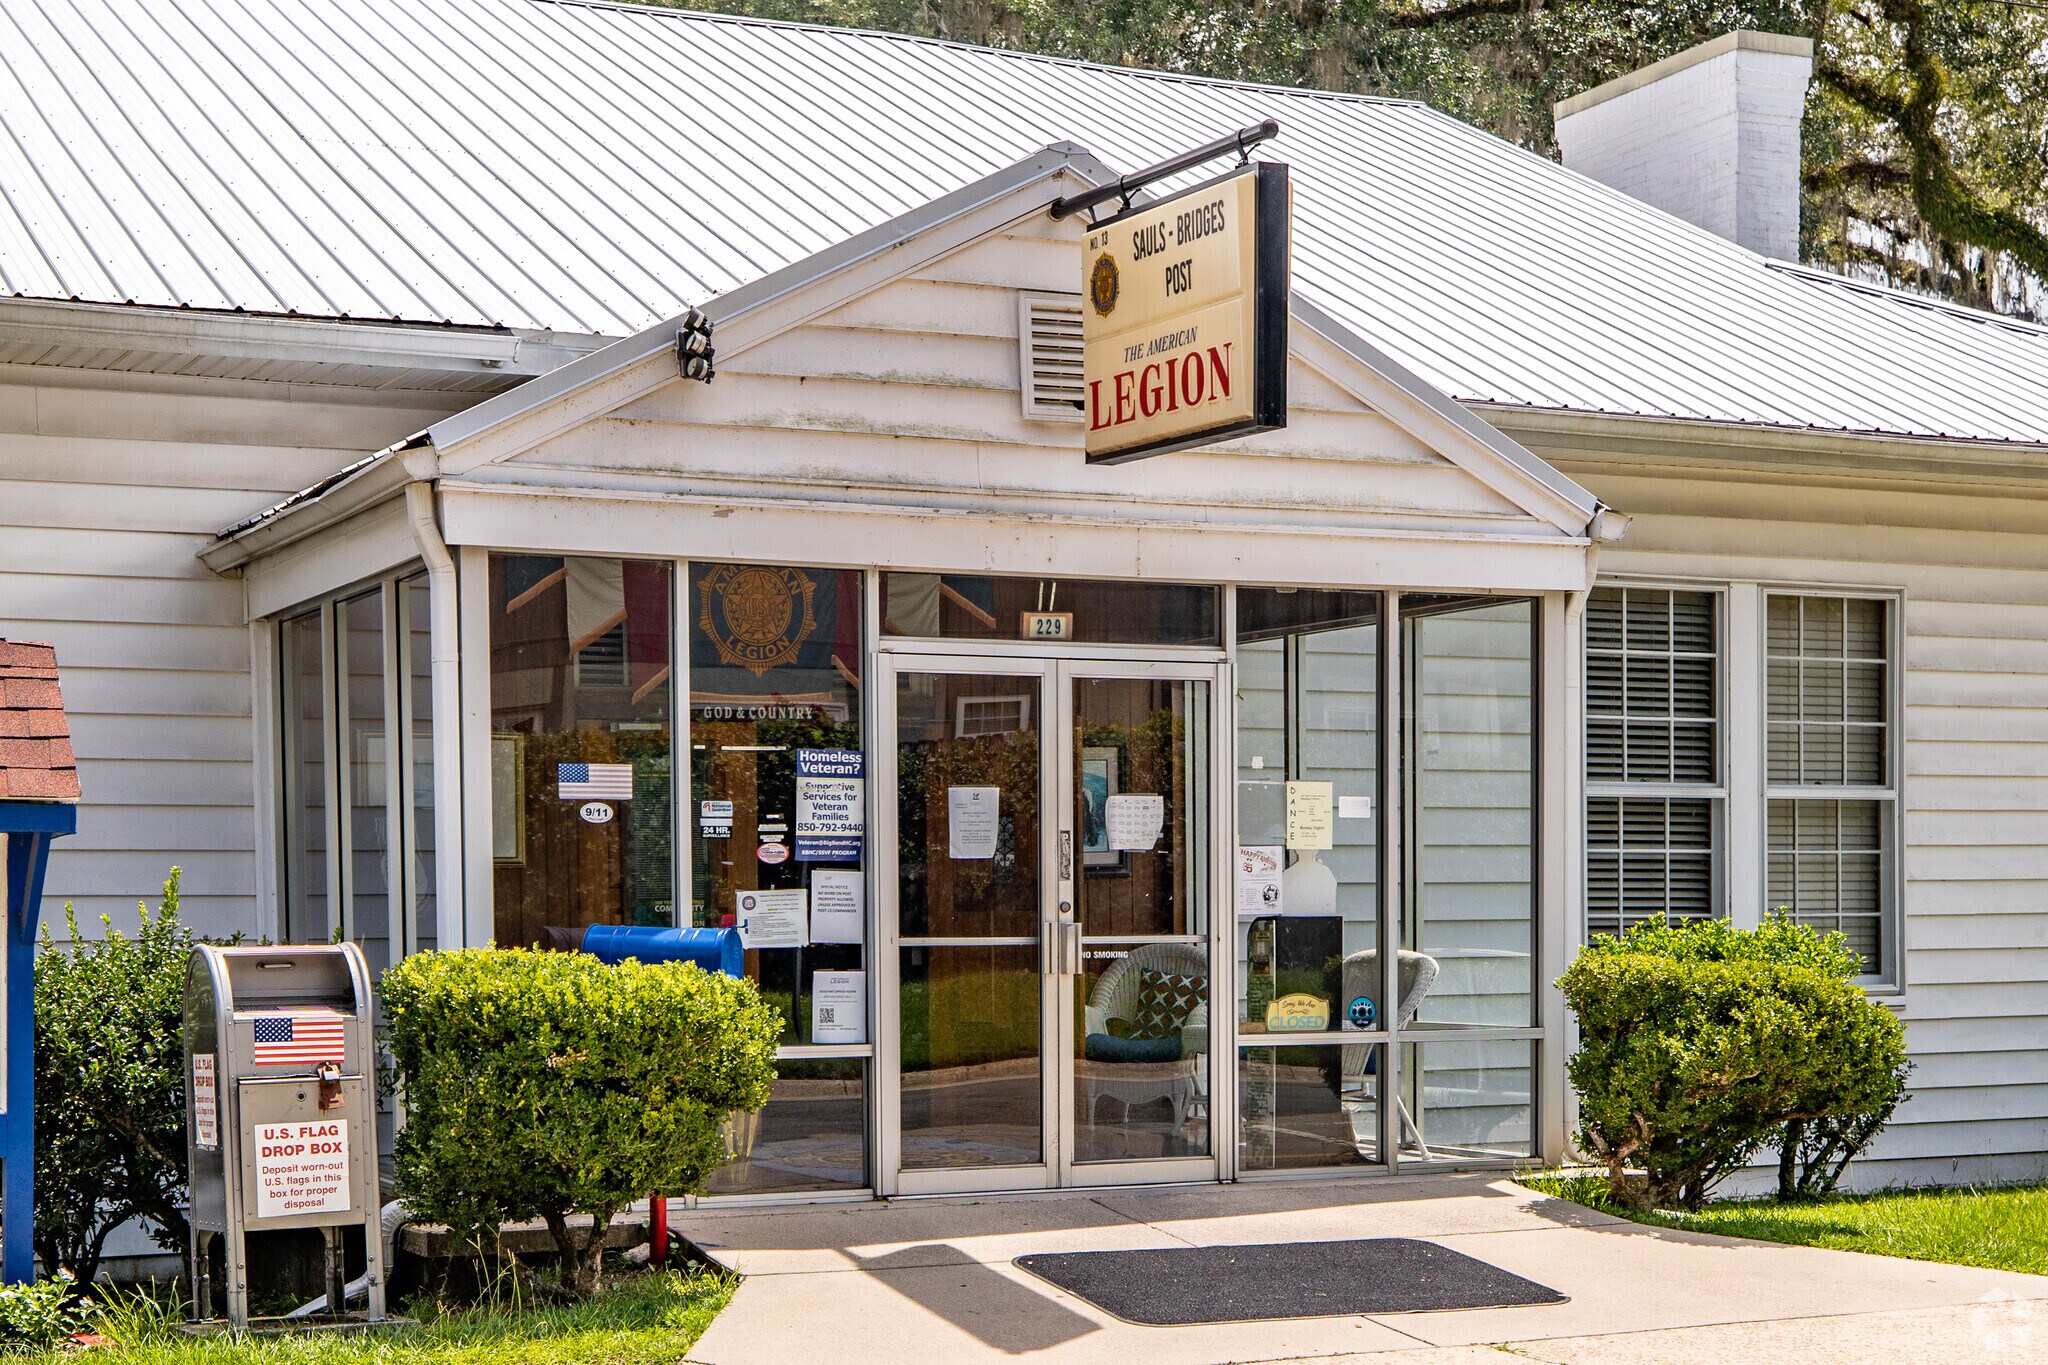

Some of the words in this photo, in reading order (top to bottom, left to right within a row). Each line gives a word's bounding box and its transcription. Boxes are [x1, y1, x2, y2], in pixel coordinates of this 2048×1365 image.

[1133, 221, 1166, 261] SAULS
[1177, 200, 1225, 246] BRIDGES
[1090, 237, 1098, 251] NO.
[1101, 231, 1108, 246] 13
[1165, 259, 1192, 297] POST
[1124, 343, 1144, 363] THE
[1146, 326, 1198, 356] AMERICAN
[1089, 342, 1232, 431] LEGION
[1037, 619, 1061, 634] 229
[726, 635, 790, 659] LEGION
[704, 706, 732, 719] GOD
[736, 707, 745, 718] &
[748, 707, 813, 719] COUNTRY
[800, 750, 862, 763] Homeless
[801, 762, 860, 774] Veteran?
[803, 792, 841, 800] Services
[844, 793, 857, 801] for
[586, 808, 607, 817] 9/11
[812, 802, 848, 810] Veteran
[798, 823, 863, 832] 850-792-9440
[1081, 951, 1091, 959] NO
[1094, 951, 1128, 959] SMOKING
[1282, 1000, 1296, 1008] Sorry
[1269, 1015, 1325, 1029] CLOSED
[264, 1128, 294, 1140] U.S.
[299, 1125, 338, 1138] FLAG
[262, 1144, 305, 1157] DROP
[310, 1142, 342, 1154] BOX
[262, 1164, 298, 1175] Deposit
[301, 1162, 343, 1171] worn-out
[265, 1177, 284, 1186] U.S.
[287, 1177, 310, 1186] flags
[324, 1173, 341, 1182] this
[270, 1190, 287, 1198] box
[307, 1187, 338, 1197] proper
[284, 1198, 324, 1209] disposal
